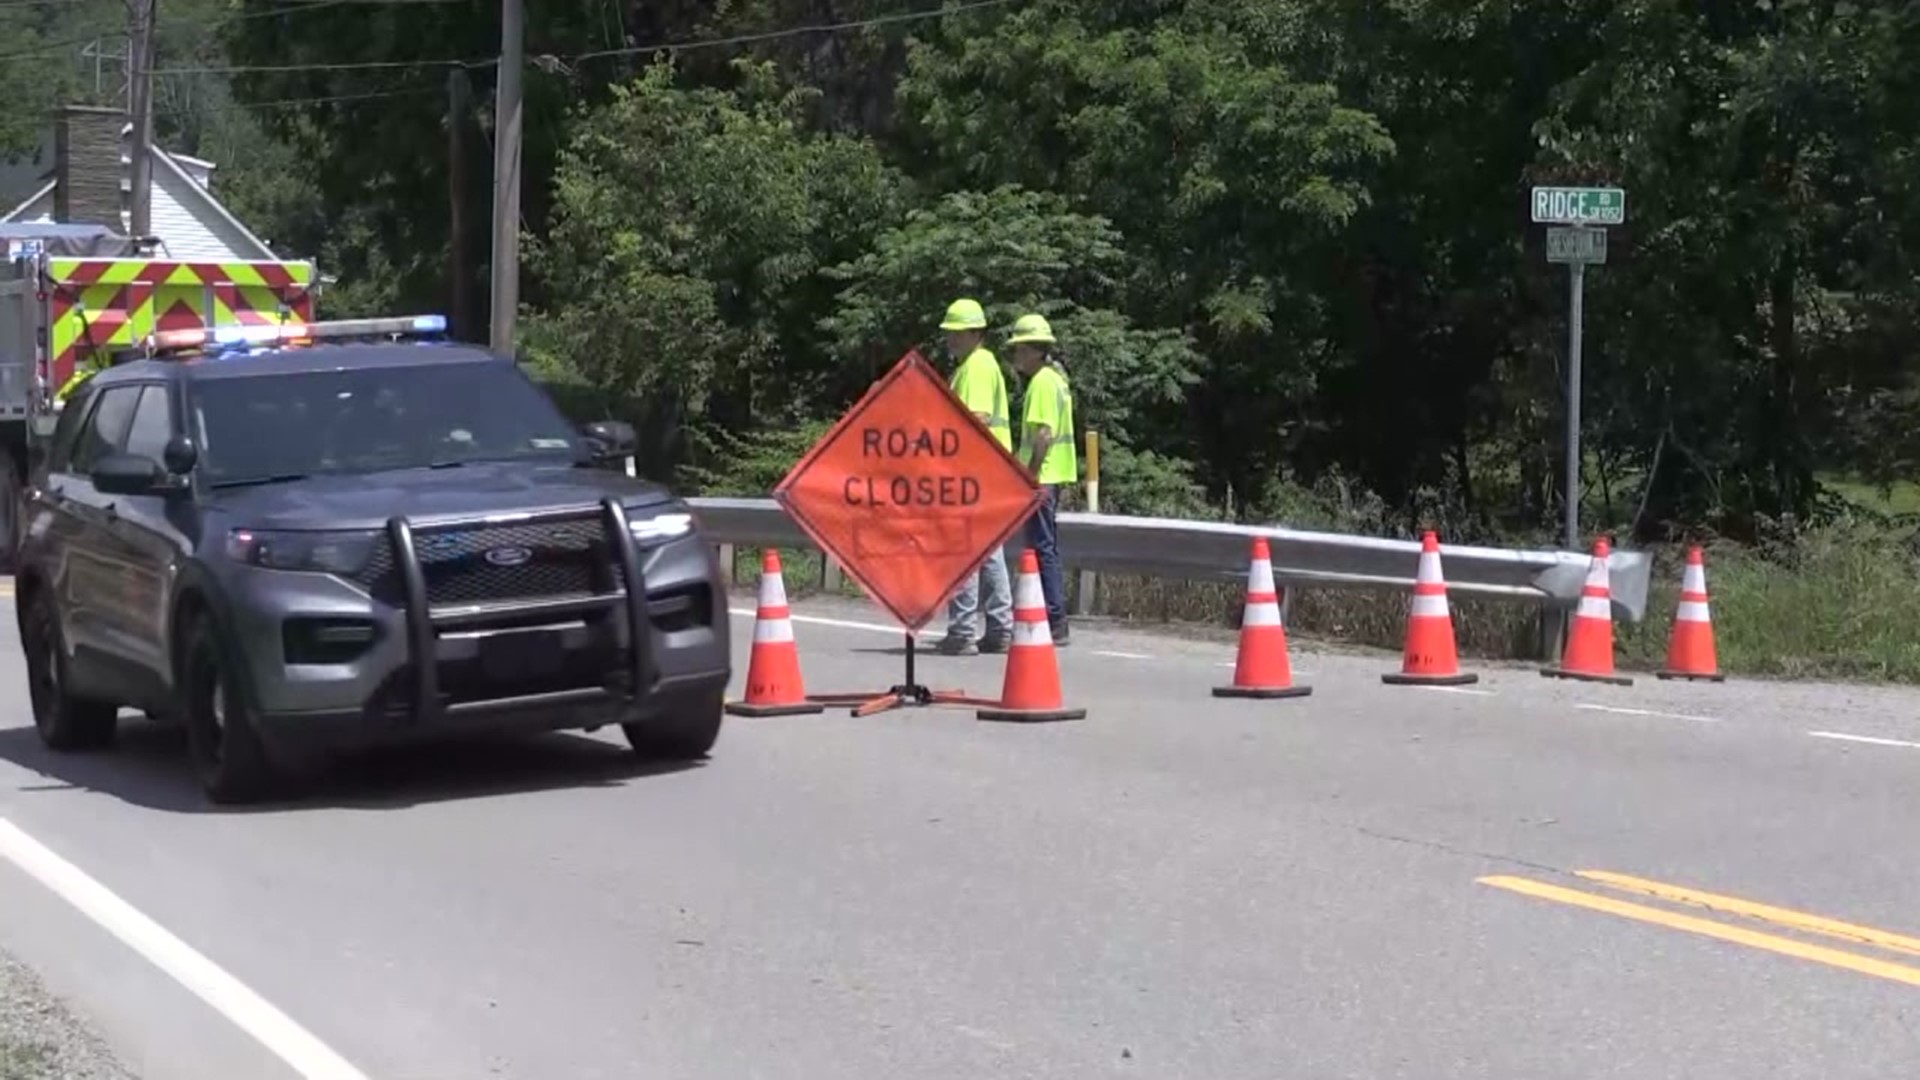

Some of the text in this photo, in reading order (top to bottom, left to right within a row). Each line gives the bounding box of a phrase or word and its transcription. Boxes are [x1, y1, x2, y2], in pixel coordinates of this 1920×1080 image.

[1536, 191, 1588, 219] RIDGE
[863, 428, 960, 458] ROAD
[844, 476, 980, 507] CLOSED
